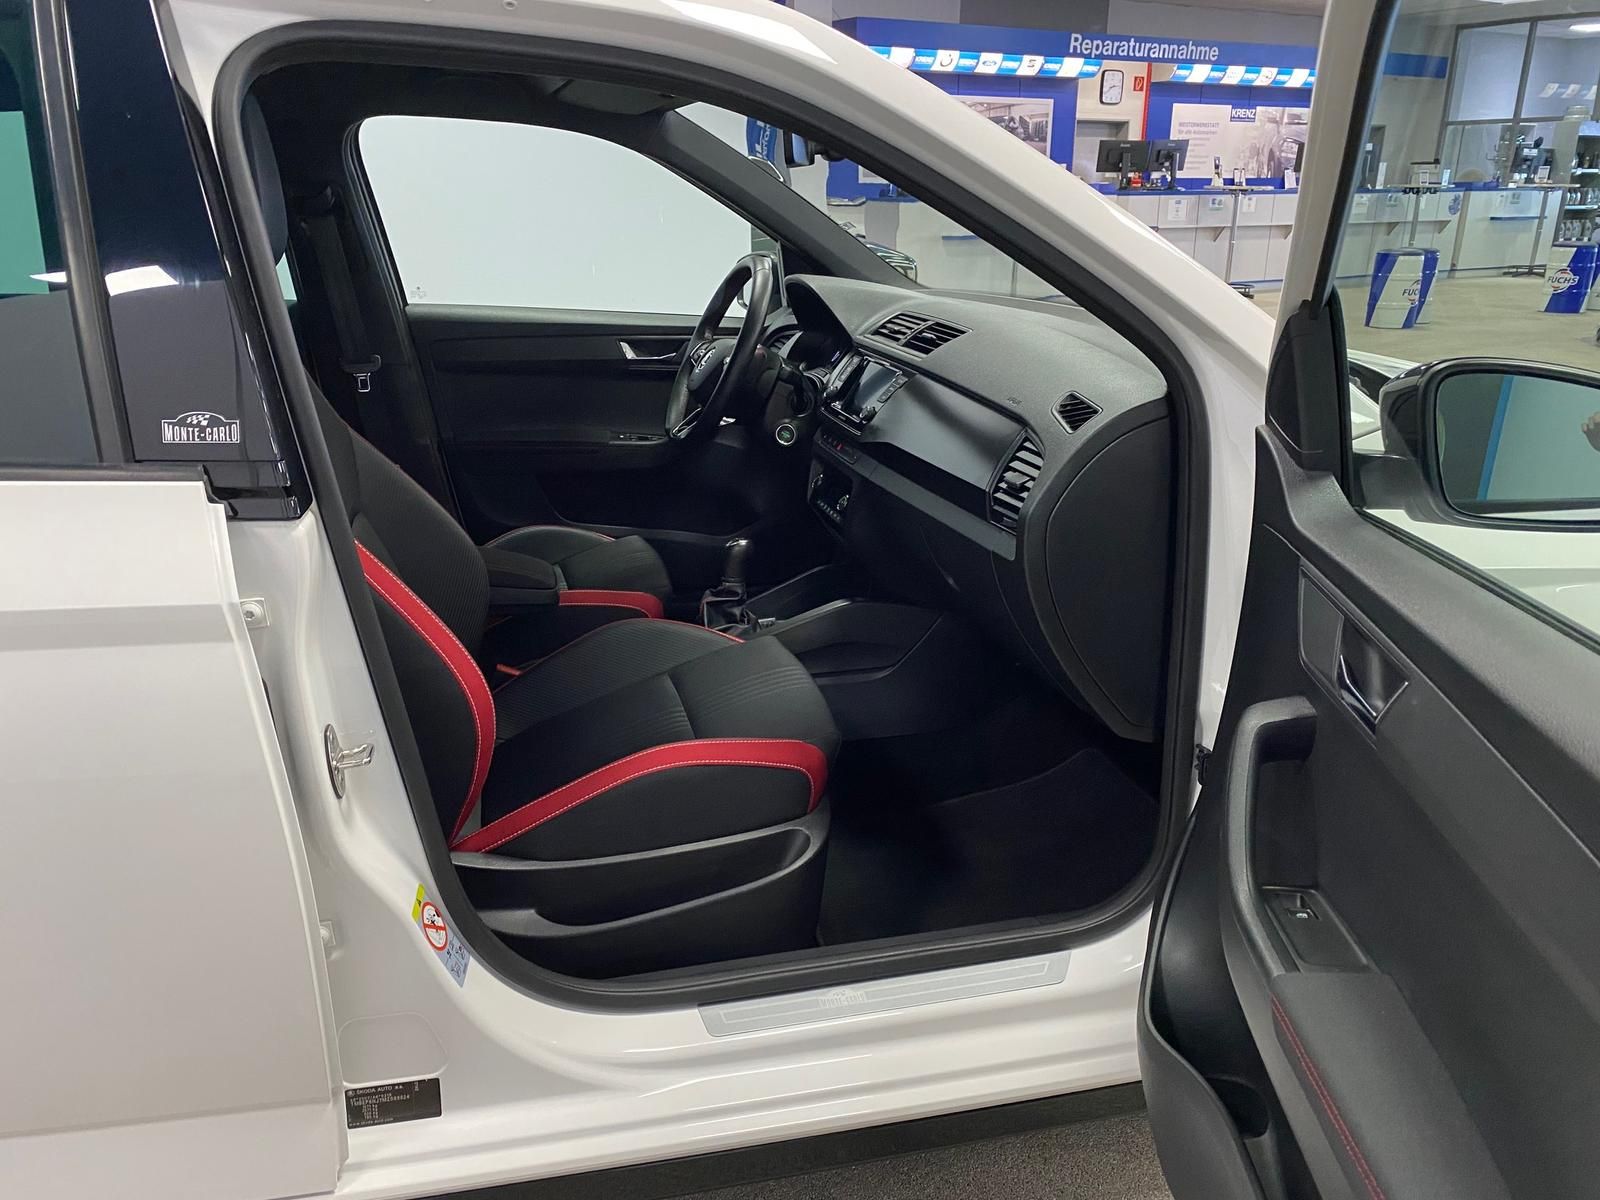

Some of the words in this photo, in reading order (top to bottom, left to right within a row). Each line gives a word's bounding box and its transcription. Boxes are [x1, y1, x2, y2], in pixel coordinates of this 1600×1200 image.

[1069, 33, 1219, 61] Reparaturannahme
[1231, 108, 1256, 118] KRENZ
[1548, 276, 1578, 284] FUCHS
[164, 423, 237, 441] MONTE-CARLO
